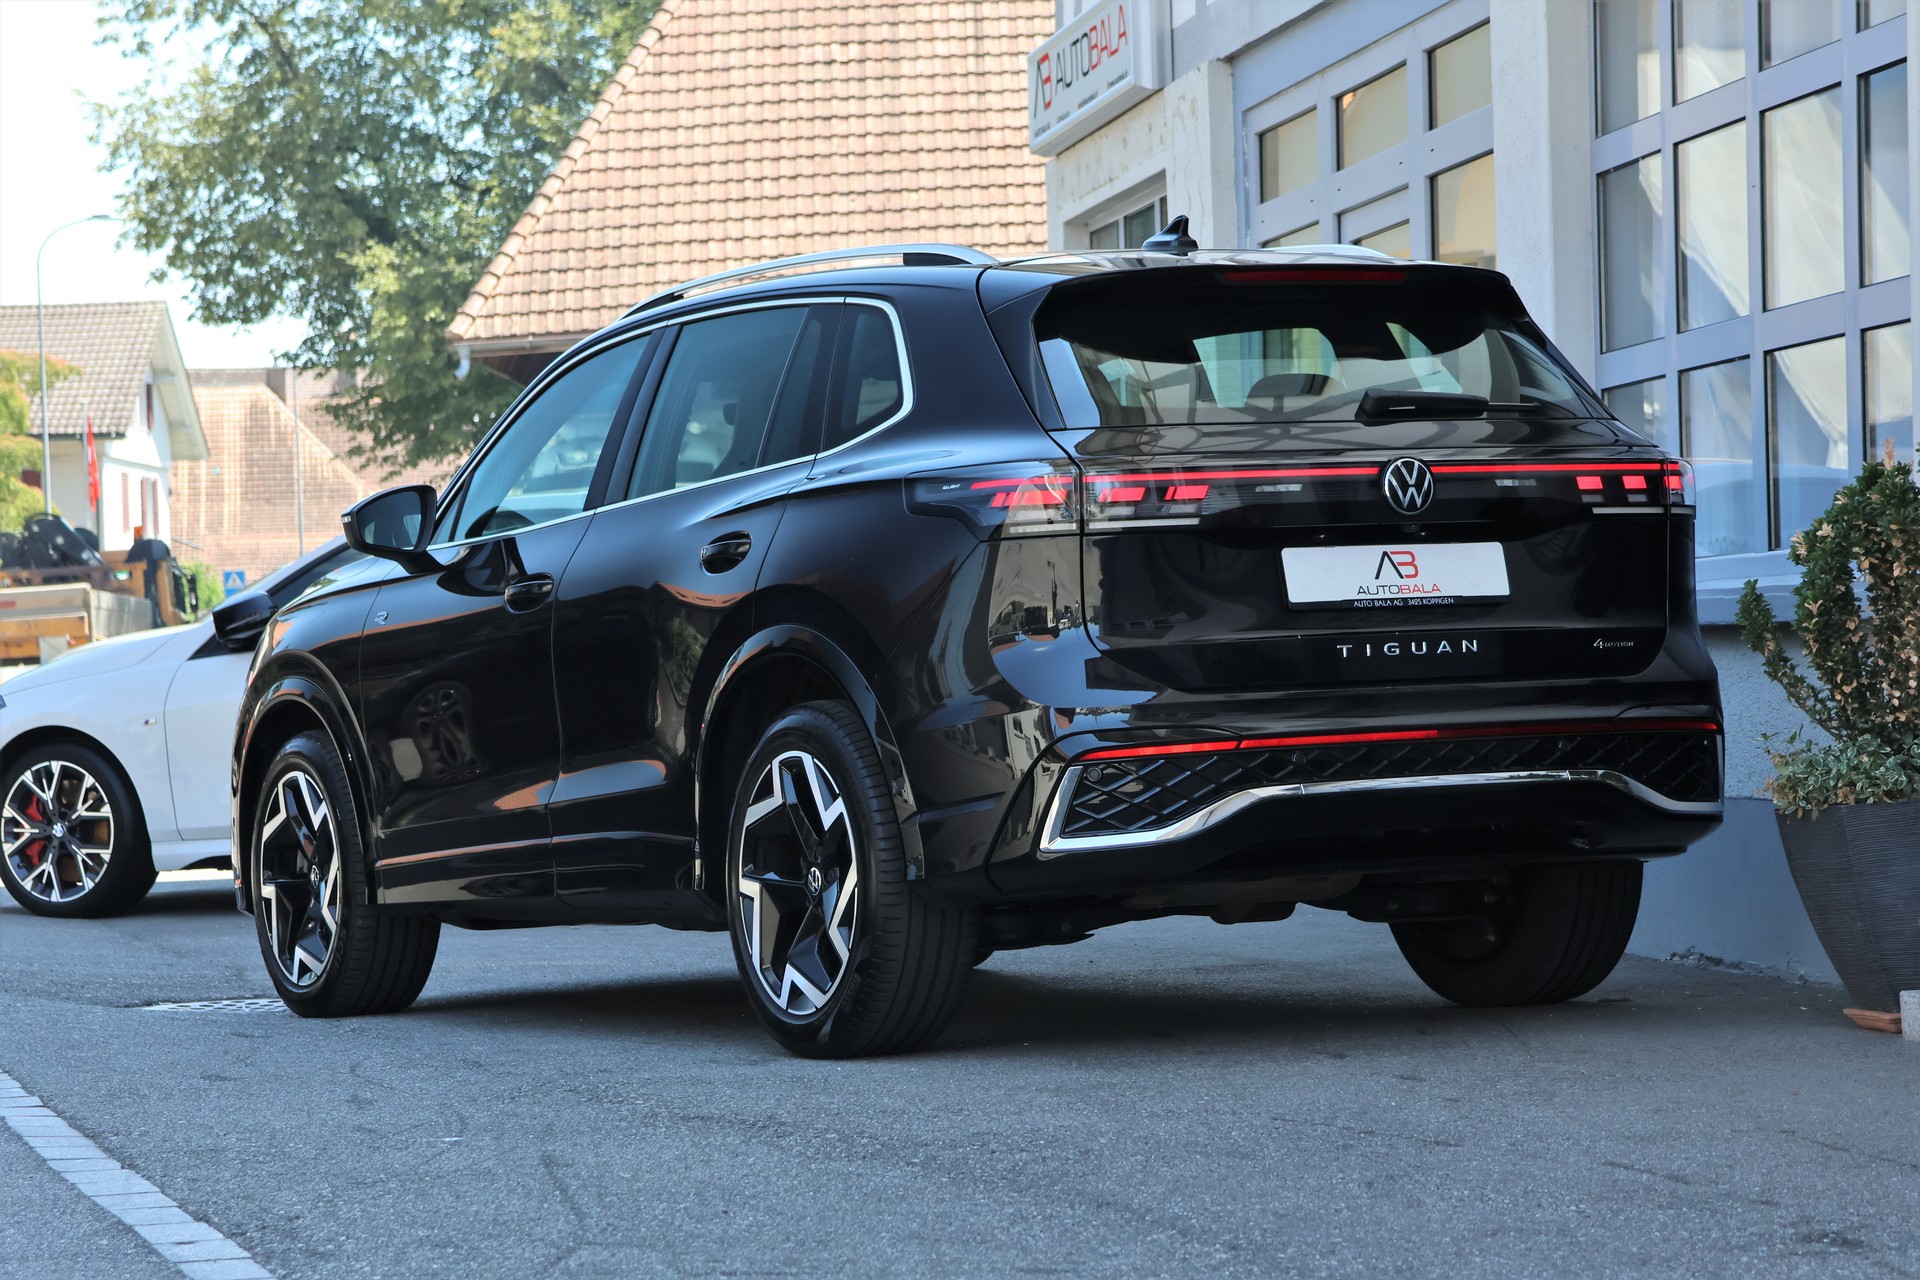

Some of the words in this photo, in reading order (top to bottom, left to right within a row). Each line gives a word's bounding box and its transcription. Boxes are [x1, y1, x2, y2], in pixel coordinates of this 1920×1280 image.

[1356, 583, 1442, 596] AUTOBALA
[1353, 599, 1373, 608] AUTO
[1374, 599, 1392, 607] BALA
[1393, 598, 1403, 606] AG
[1407, 598, 1422, 606] 3425
[1422, 597, 1454, 605] KOPPIGEN
[1336, 639, 1479, 658] TIGUAN
